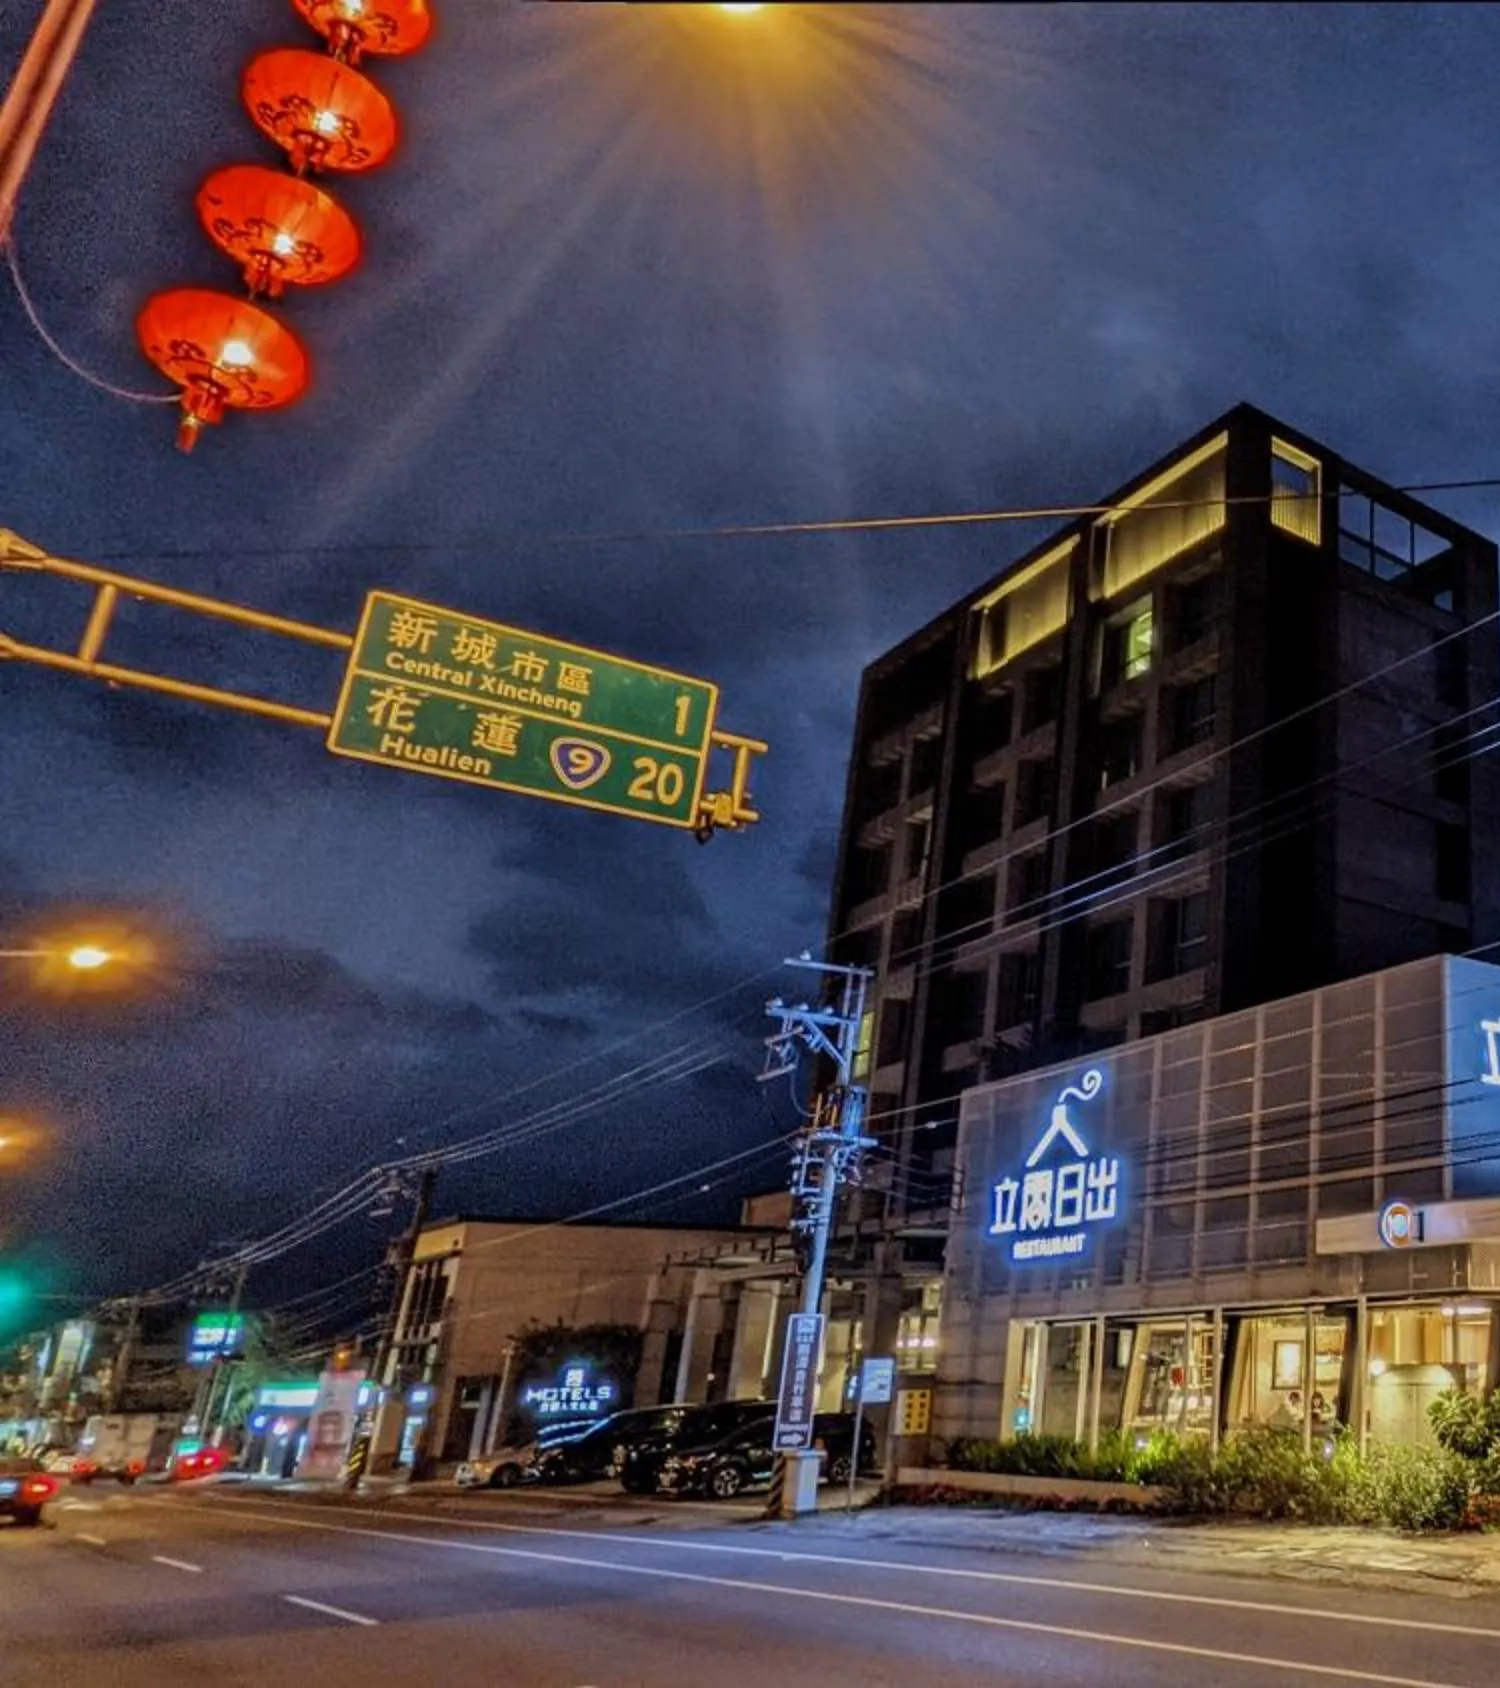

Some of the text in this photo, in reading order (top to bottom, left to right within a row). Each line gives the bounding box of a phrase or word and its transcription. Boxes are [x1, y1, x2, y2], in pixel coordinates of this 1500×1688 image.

[388, 611, 593, 697] 新城市區
[385, 651, 583, 718] Central Xincheng
[366, 684, 524, 757] 花蓮
[673, 694, 692, 737] 1
[379, 732, 492, 777] Hualien
[567, 746, 595, 775] 9
[627, 756, 685, 806] 20
